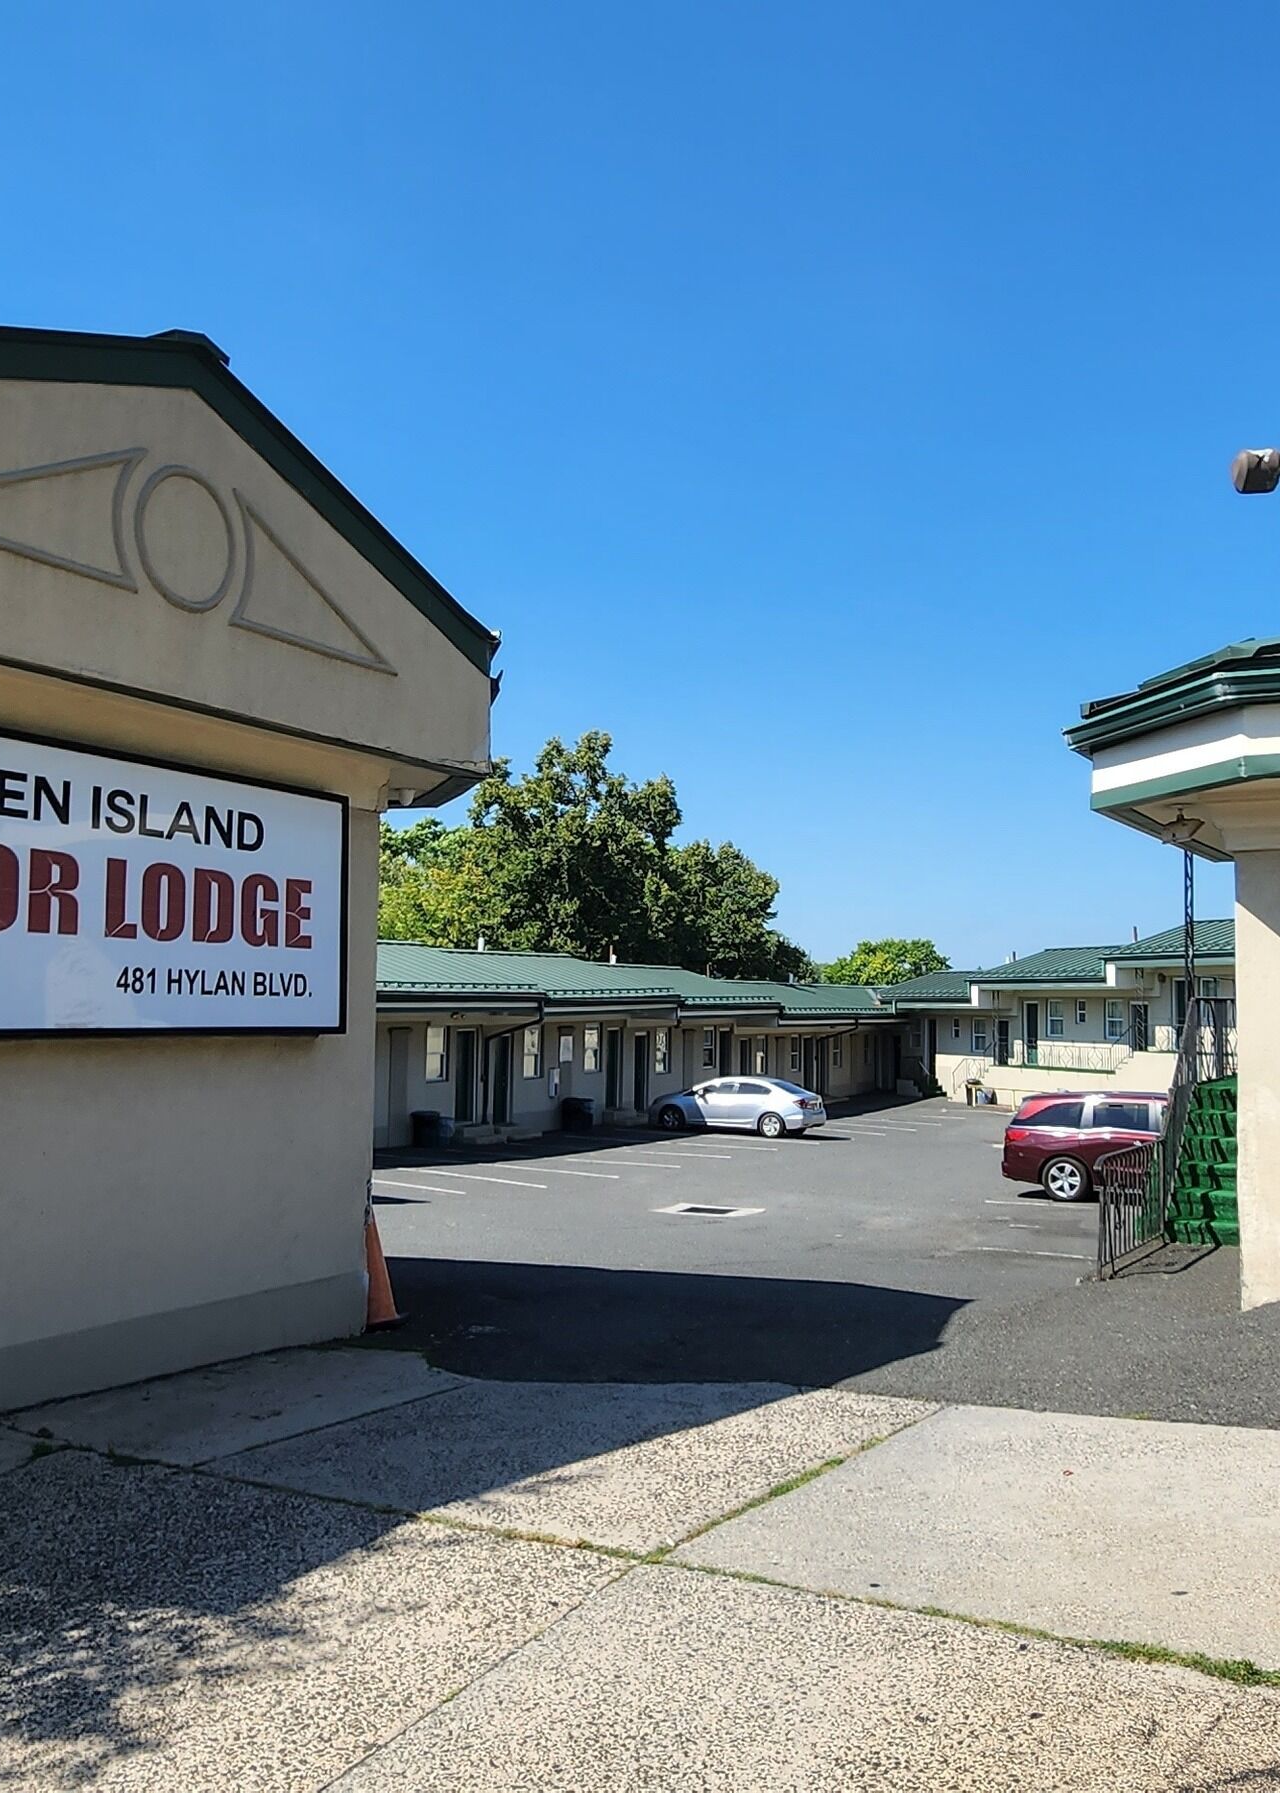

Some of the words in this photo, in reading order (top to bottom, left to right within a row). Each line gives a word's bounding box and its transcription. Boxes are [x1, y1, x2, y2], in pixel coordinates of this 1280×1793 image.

[91, 785, 266, 853] ISLAND
[103, 857, 313, 950] LODGE
[115, 965, 158, 996] 481
[166, 967, 246, 998] HYLAN
[253, 971, 313, 999] BLVD.
